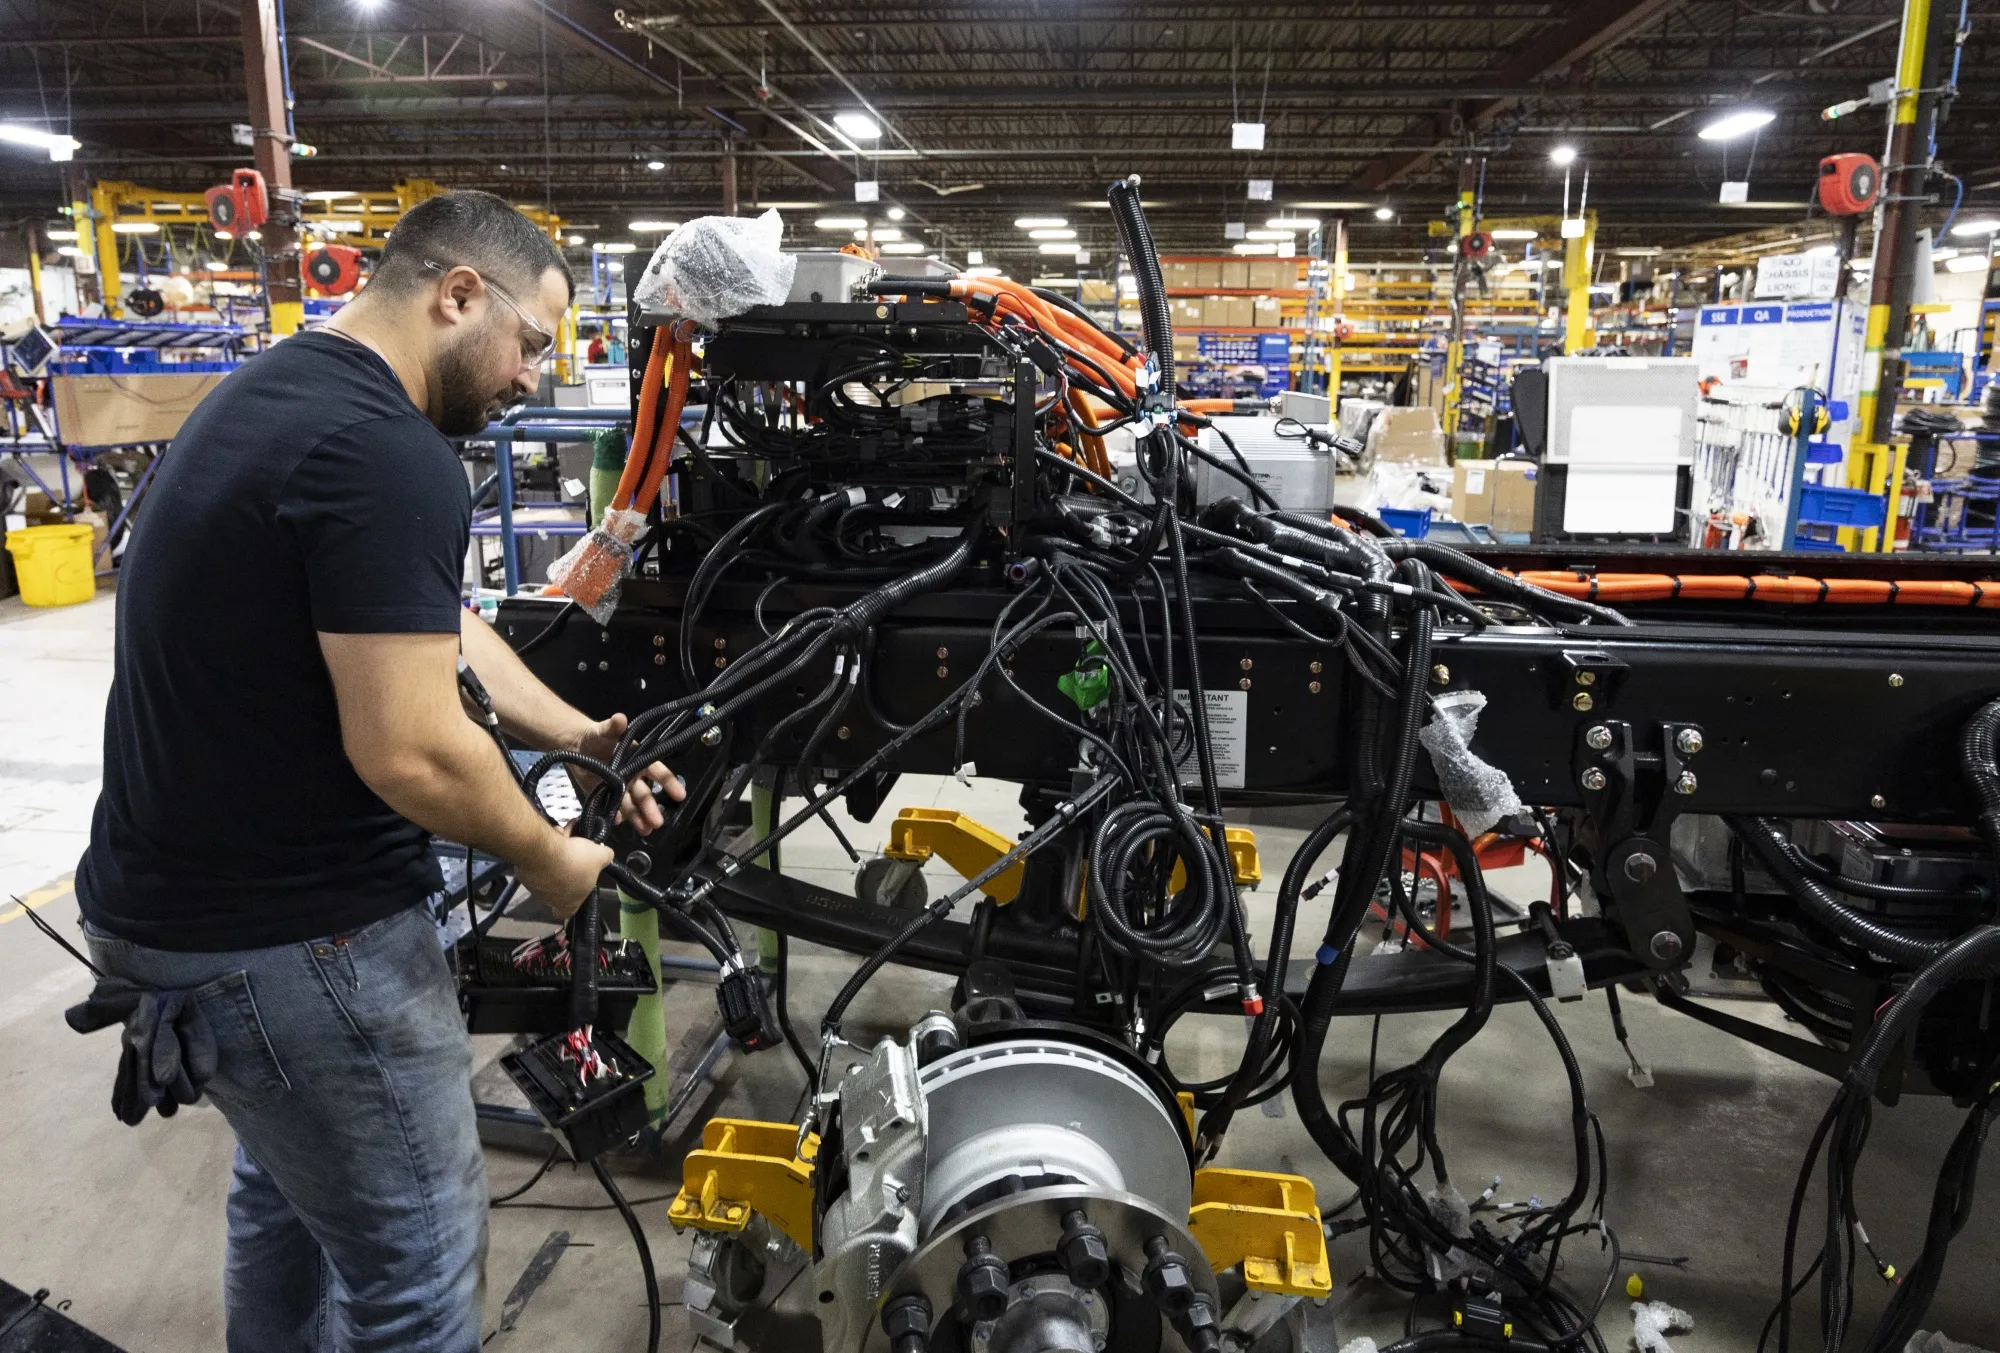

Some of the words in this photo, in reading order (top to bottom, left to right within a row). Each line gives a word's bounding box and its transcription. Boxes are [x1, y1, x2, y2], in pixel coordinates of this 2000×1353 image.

[1711, 311, 1727, 323] SSE
[1754, 310, 1770, 322] QA
[1786, 308, 1832, 318] PRODUCTION
[1178, 693, 1229, 701] IMPTANT
